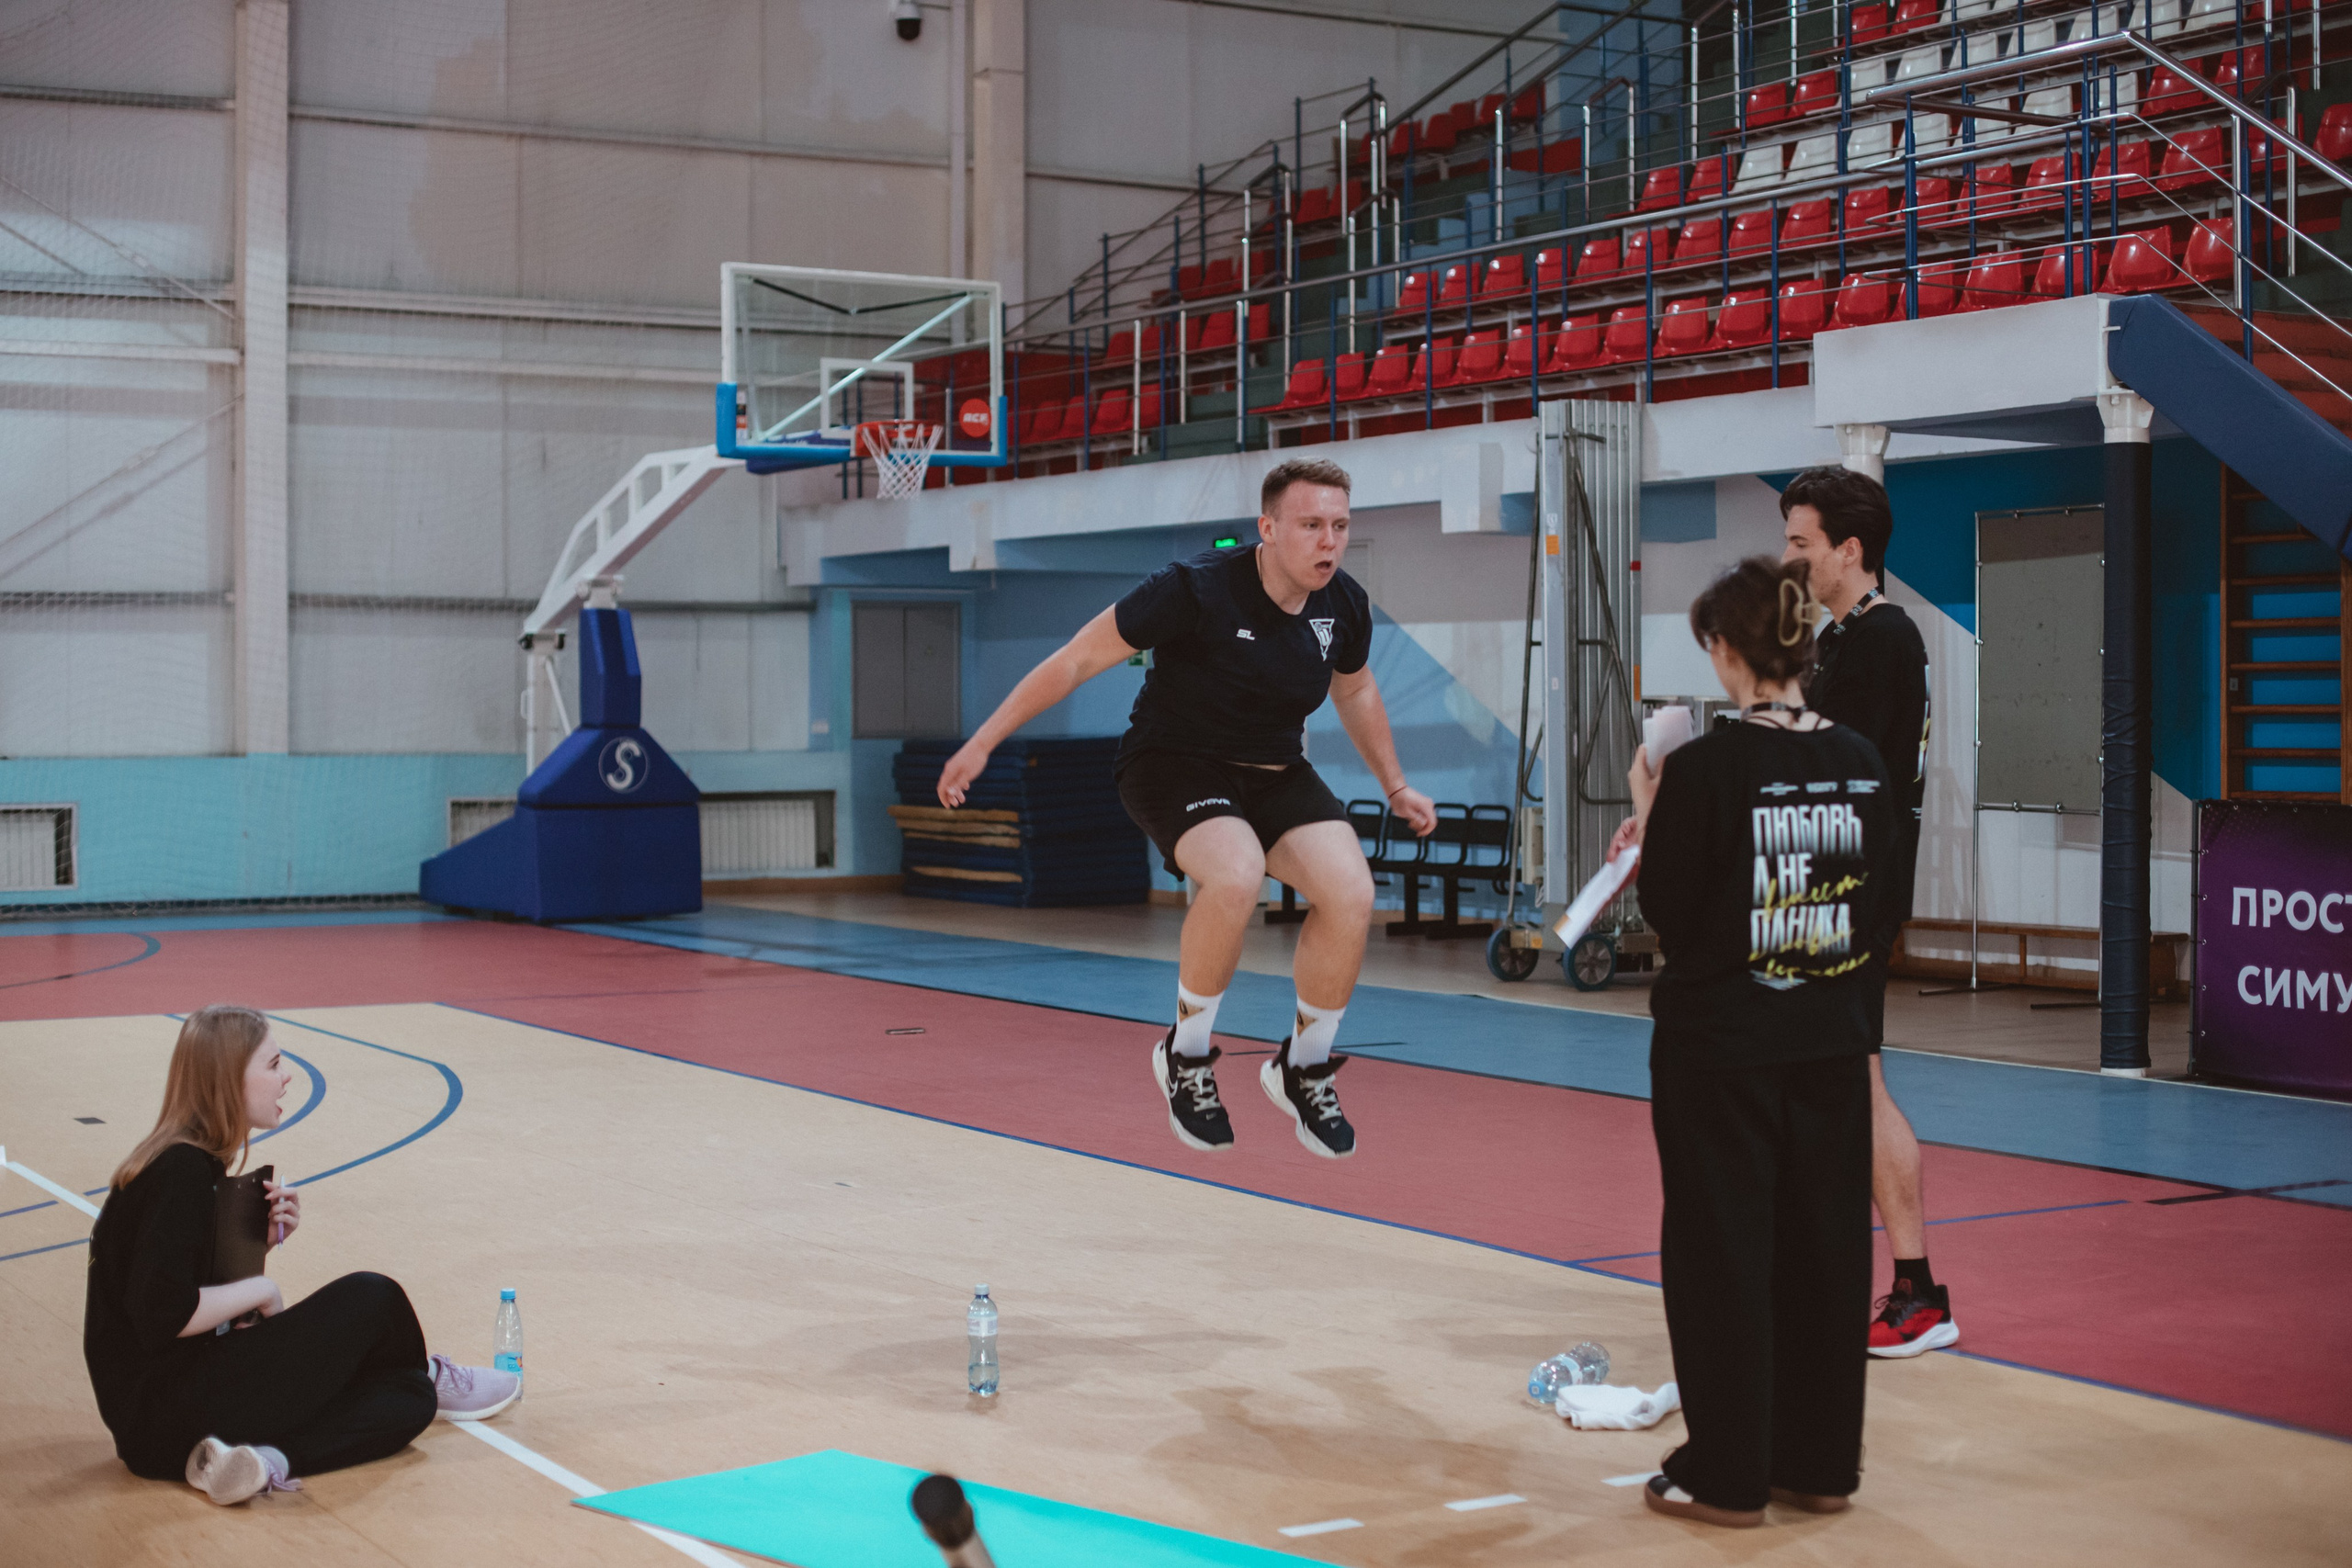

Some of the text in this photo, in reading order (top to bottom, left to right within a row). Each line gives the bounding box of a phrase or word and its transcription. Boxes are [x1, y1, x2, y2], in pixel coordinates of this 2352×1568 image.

[1236, 628, 1255, 640] SL
[1777, 852, 1813, 900] НЕ
[2232, 887, 2352, 933] ПРОС
